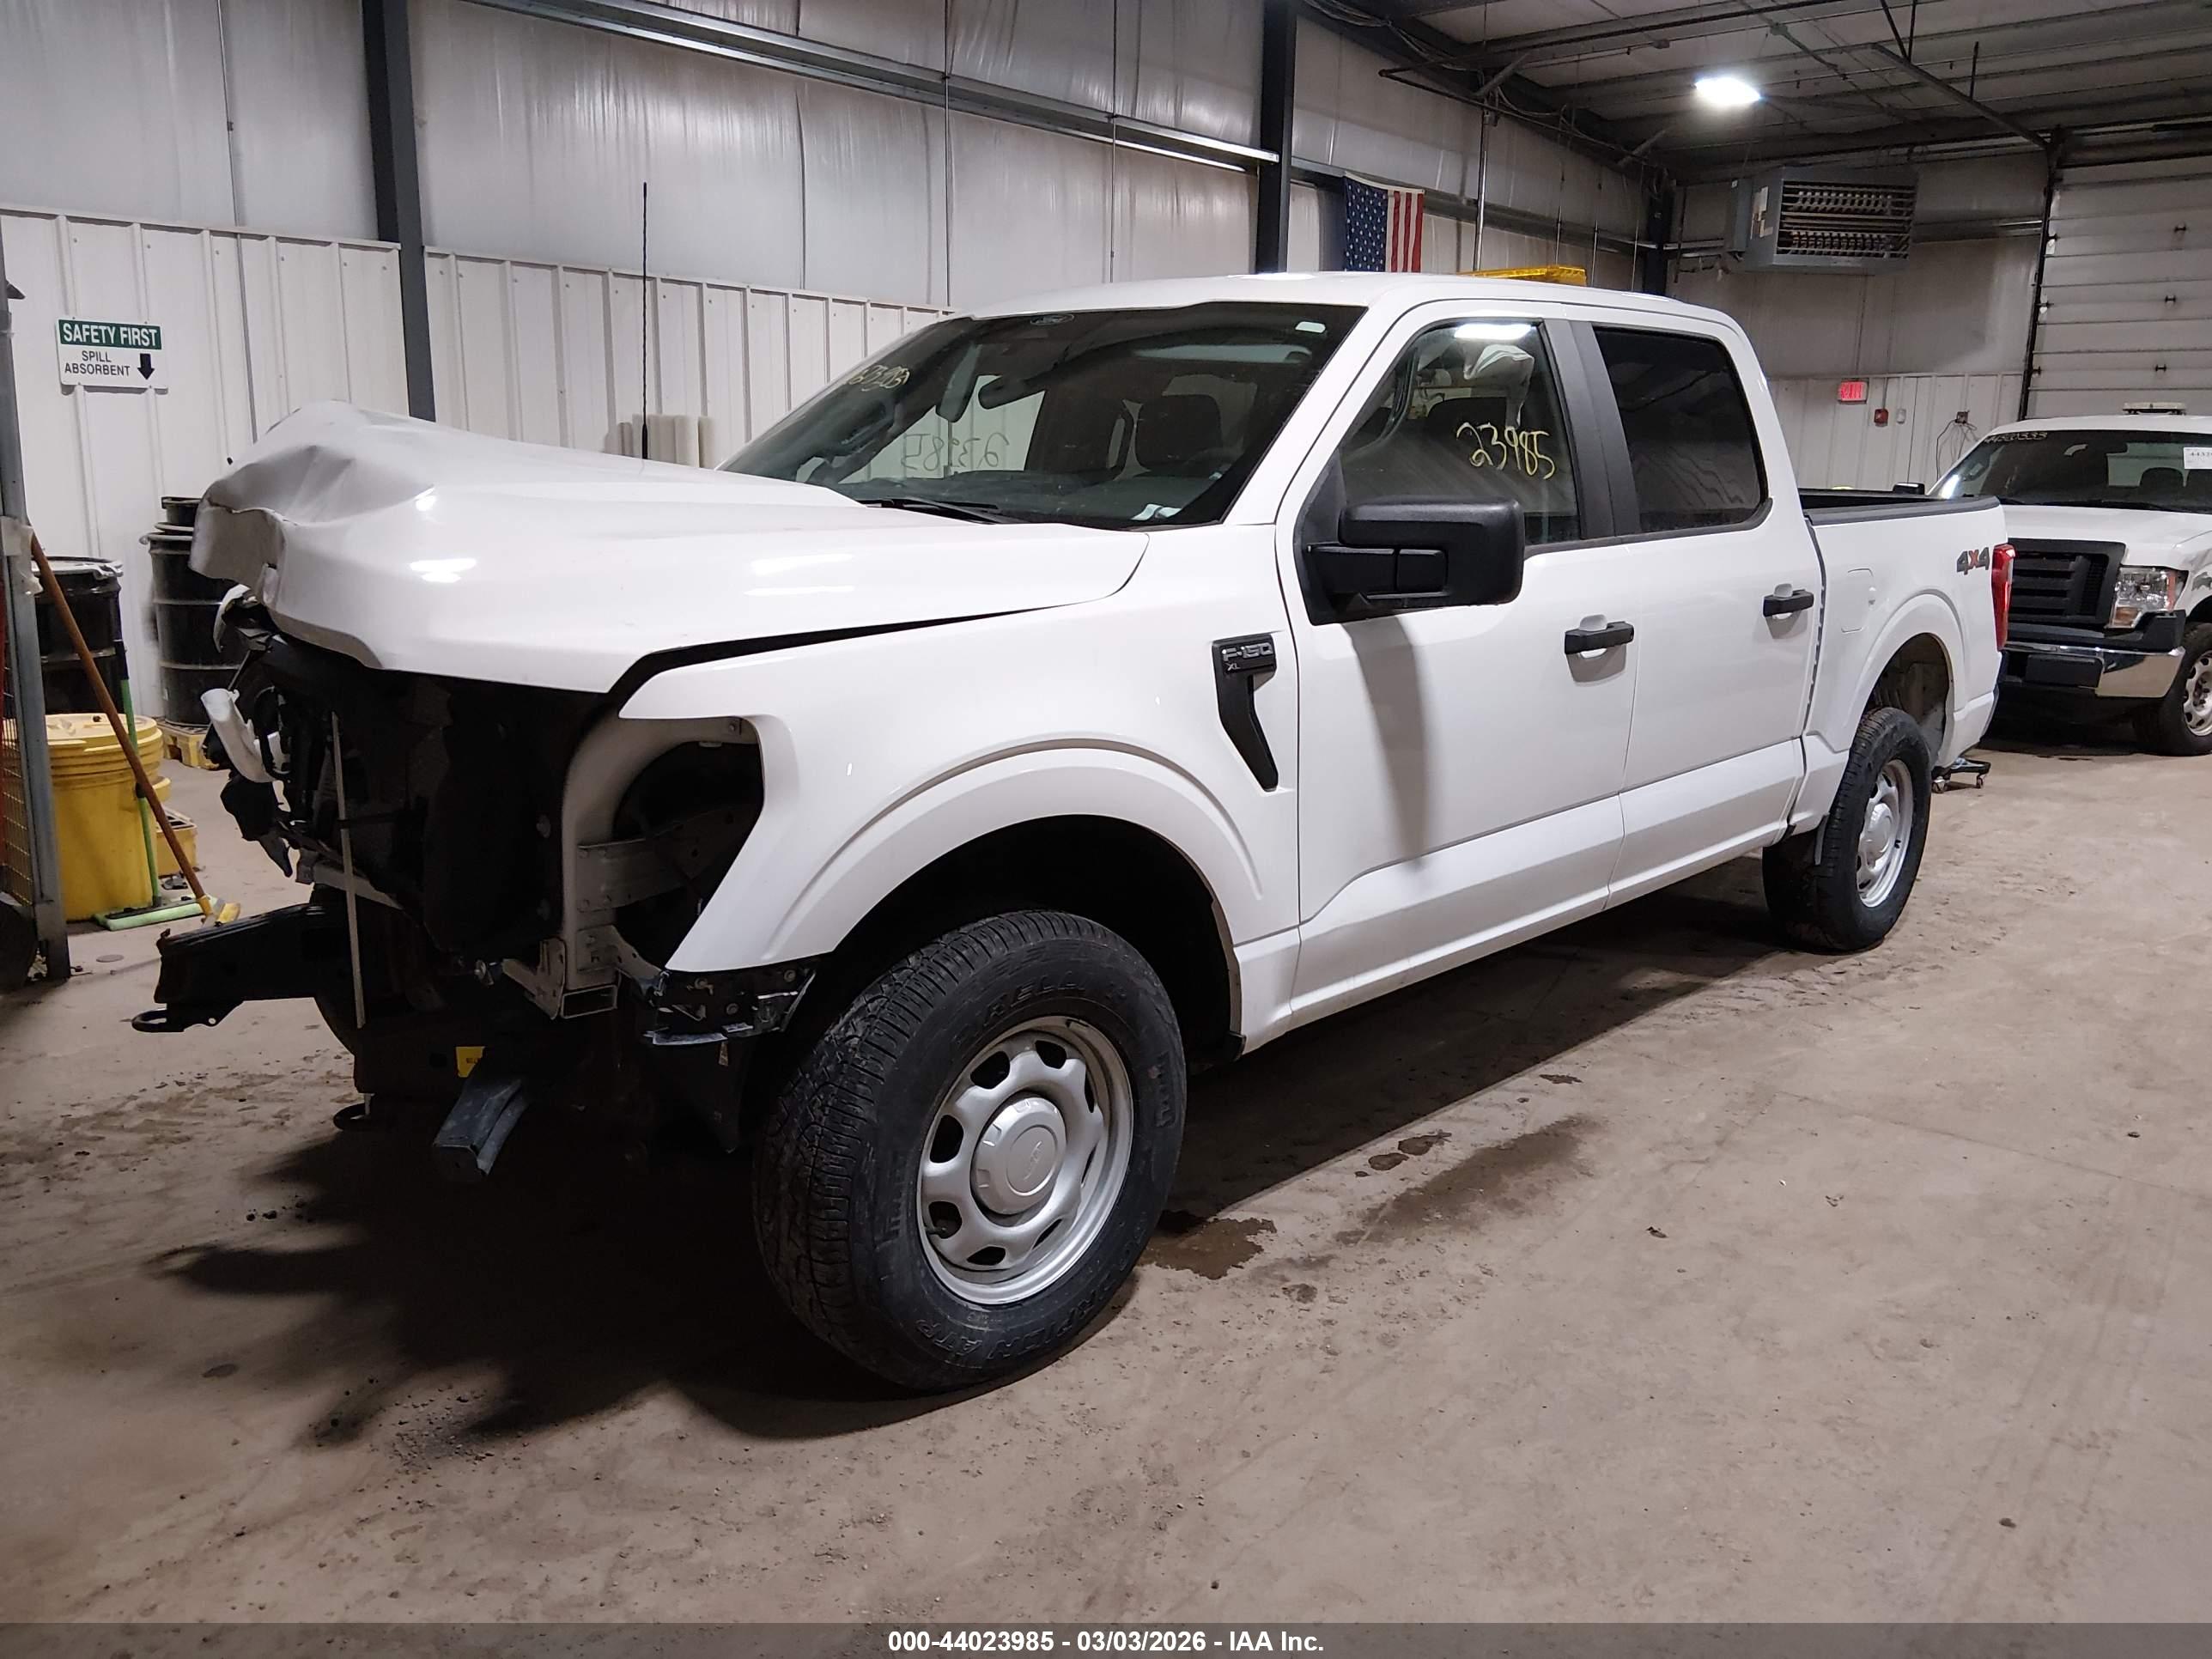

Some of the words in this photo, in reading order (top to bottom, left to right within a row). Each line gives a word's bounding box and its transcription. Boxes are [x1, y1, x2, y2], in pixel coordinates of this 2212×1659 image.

[63, 323, 115, 343] SAFETY
[120, 327, 157, 346] FIRST
[82, 350, 112, 362] SPILL
[64, 362, 131, 376] ABSORBENT
[1456, 422, 1555, 479] 23985
[1222, 642, 1273, 661] F-150
